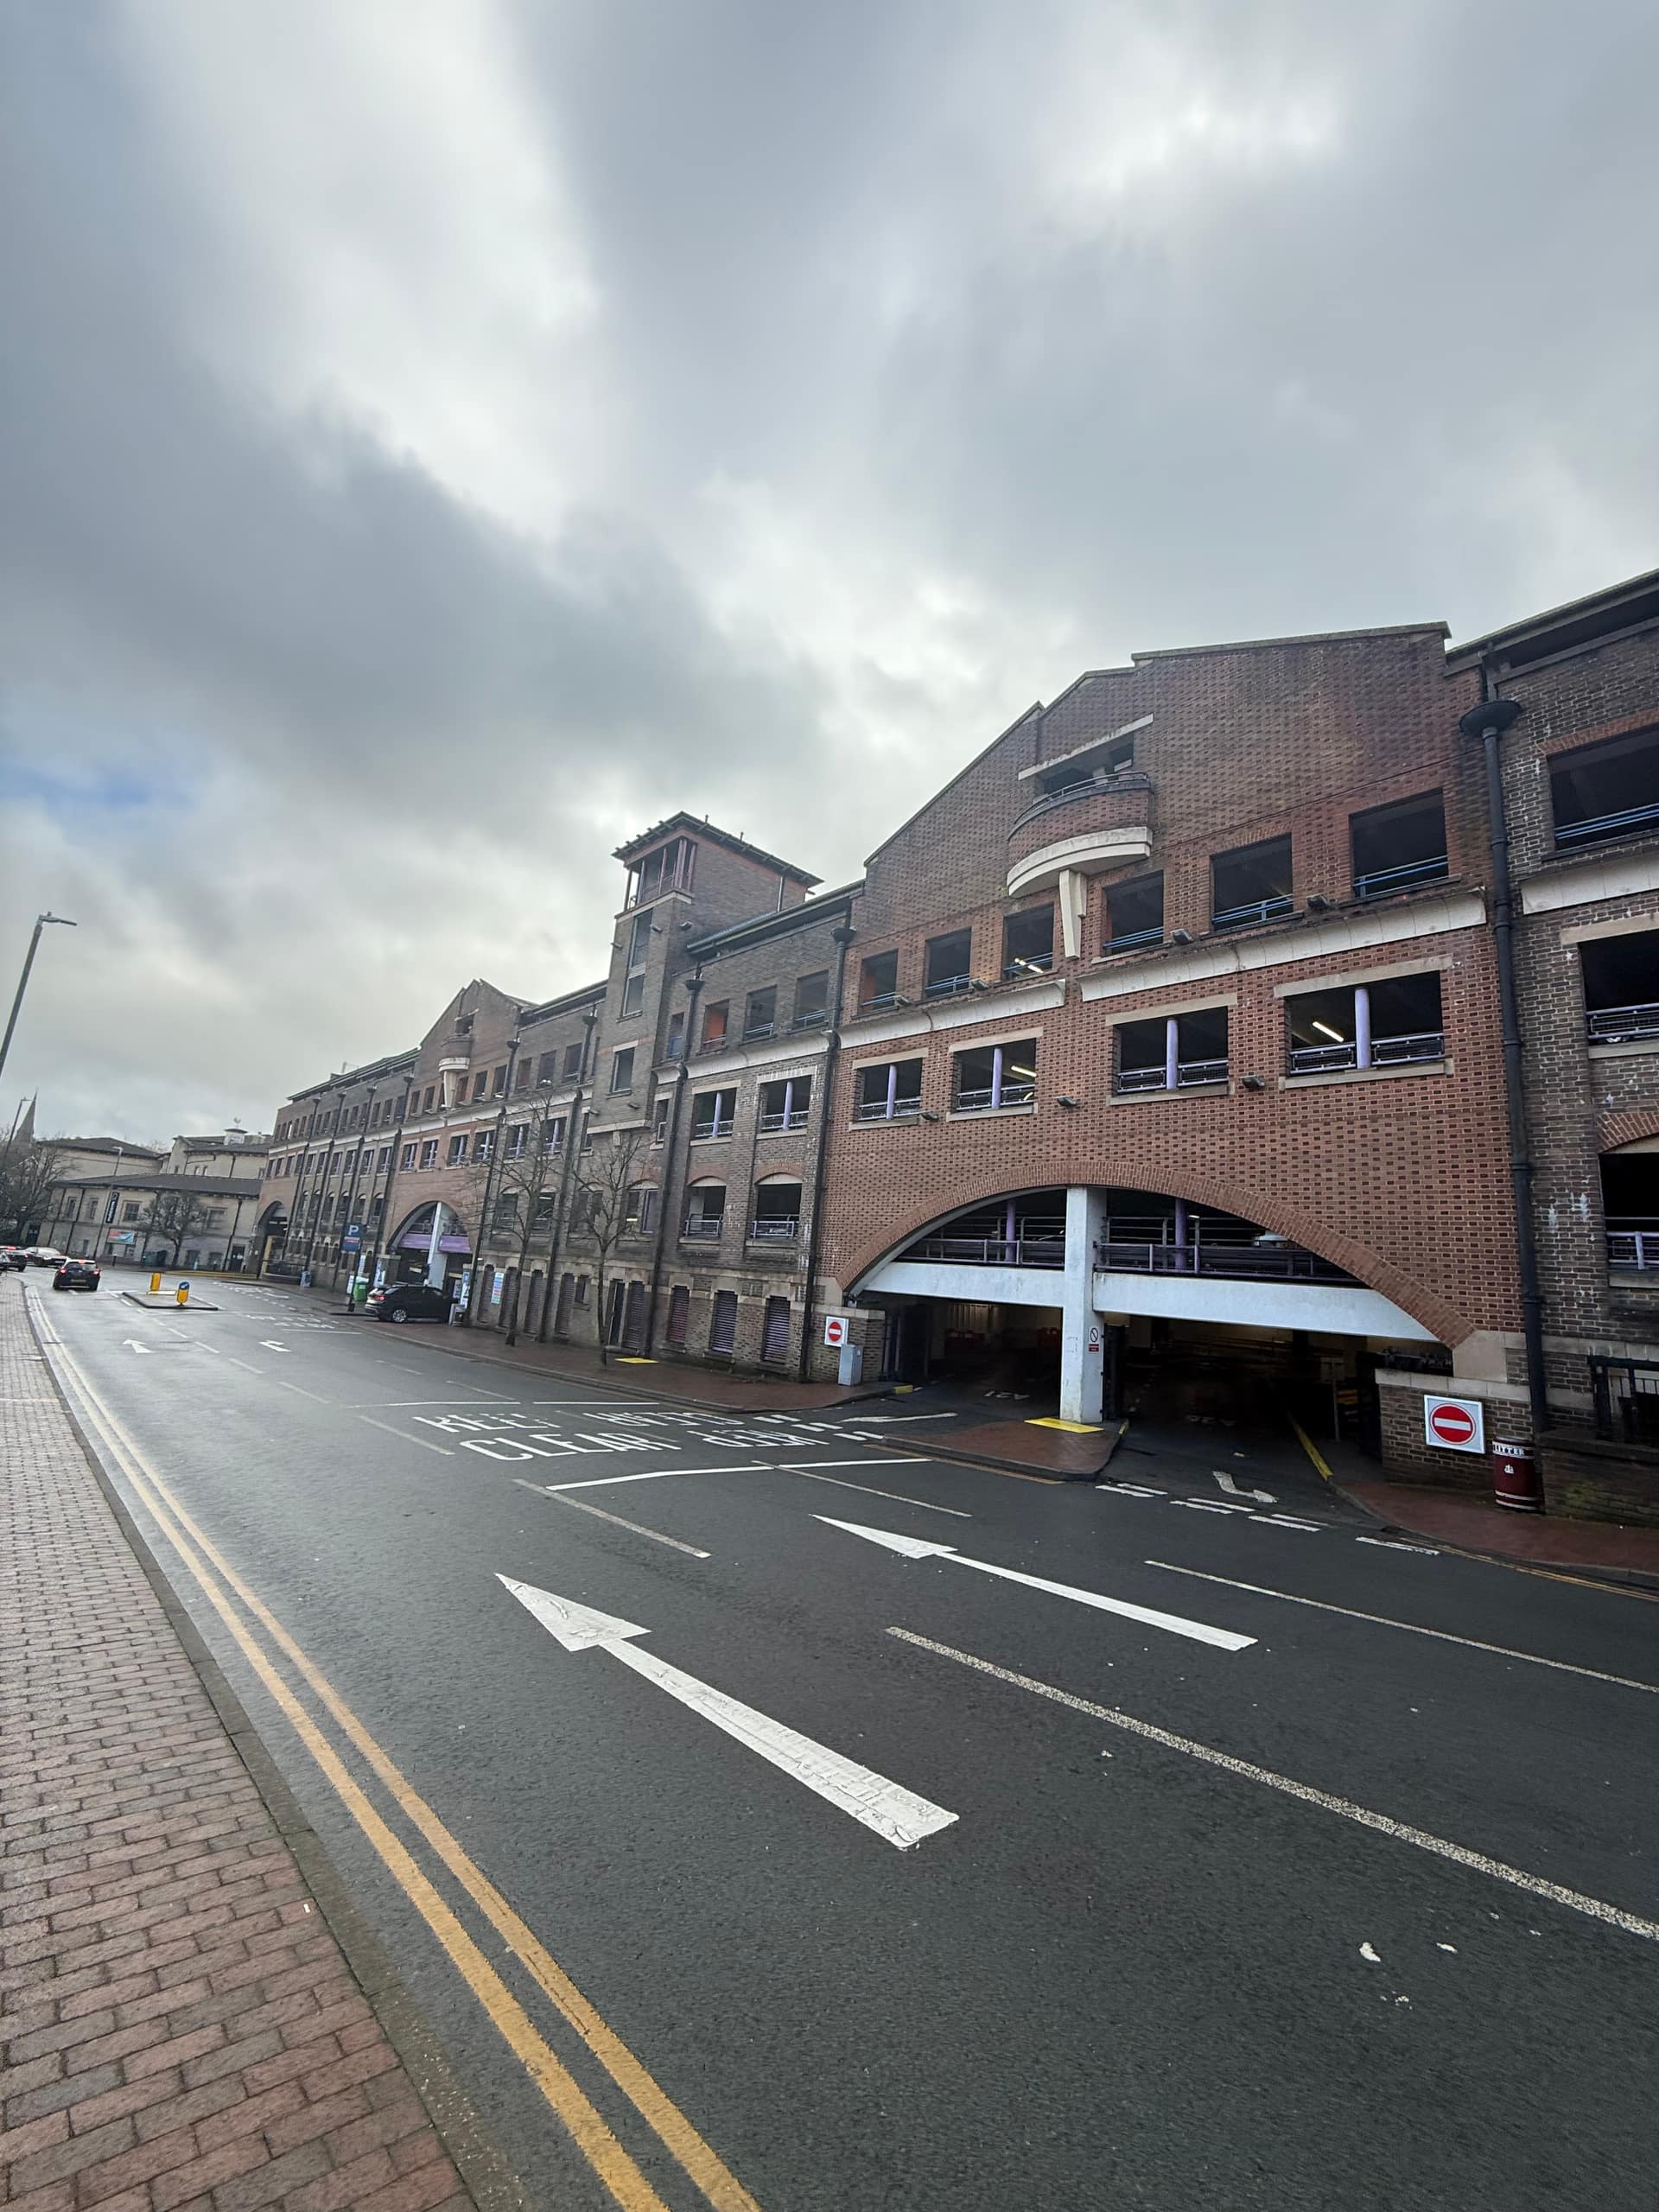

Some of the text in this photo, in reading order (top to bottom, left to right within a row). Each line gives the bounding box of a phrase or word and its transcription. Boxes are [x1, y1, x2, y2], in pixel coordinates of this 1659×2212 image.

[347, 1224, 359, 1236] P
[412, 1414, 561, 1433] KEEP
[582, 1412, 745, 1427] CLEAR
[687, 1429, 830, 1447] KEEP
[459, 1433, 682, 1461] CLEAR
[1492, 1444, 1525, 1456] LITTER
